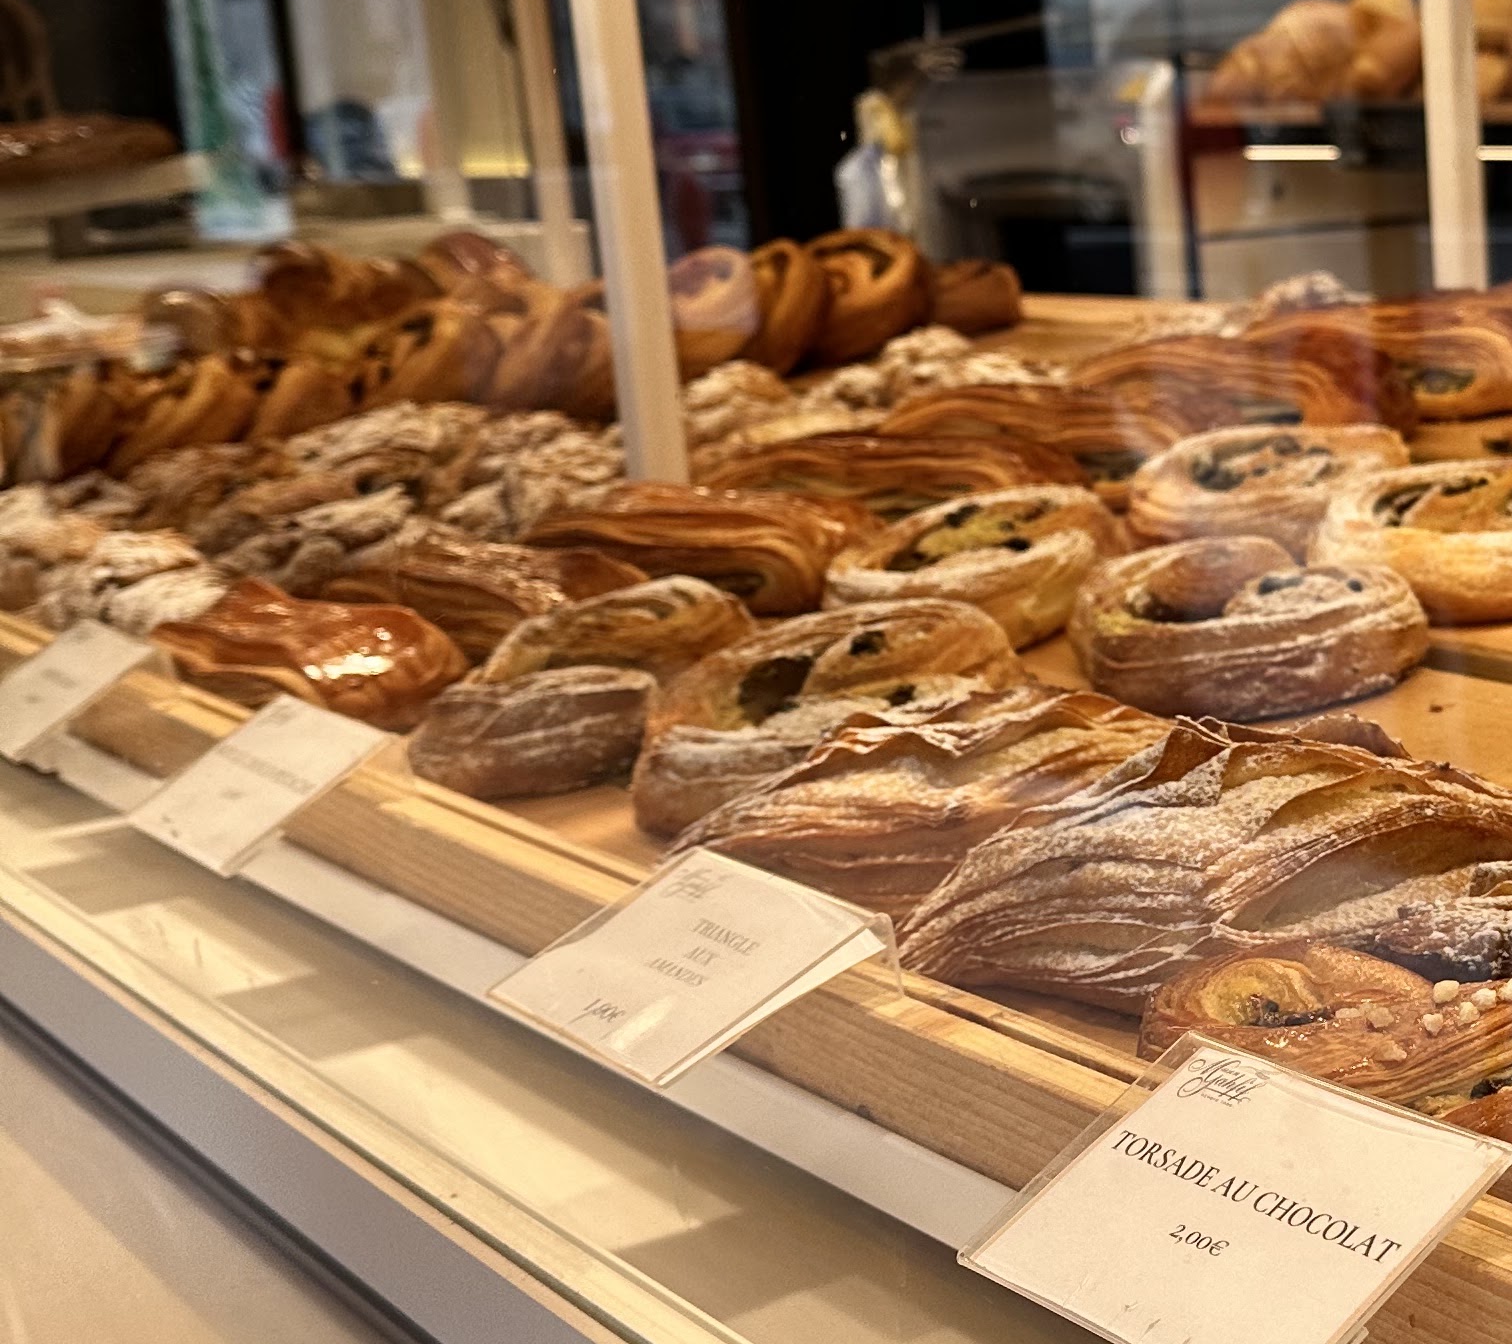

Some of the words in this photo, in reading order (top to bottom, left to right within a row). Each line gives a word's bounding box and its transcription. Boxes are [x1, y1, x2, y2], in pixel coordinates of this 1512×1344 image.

[691, 917, 760, 956] TRIANGLE
[684, 945, 720, 967] AUX
[1110, 1130, 1220, 1188] TORSADE
[1210, 1176, 1259, 1203] AU
[1253, 1190, 1402, 1263] CHOCOLAT
[1168, 1223, 1230, 1257] 2,00€
